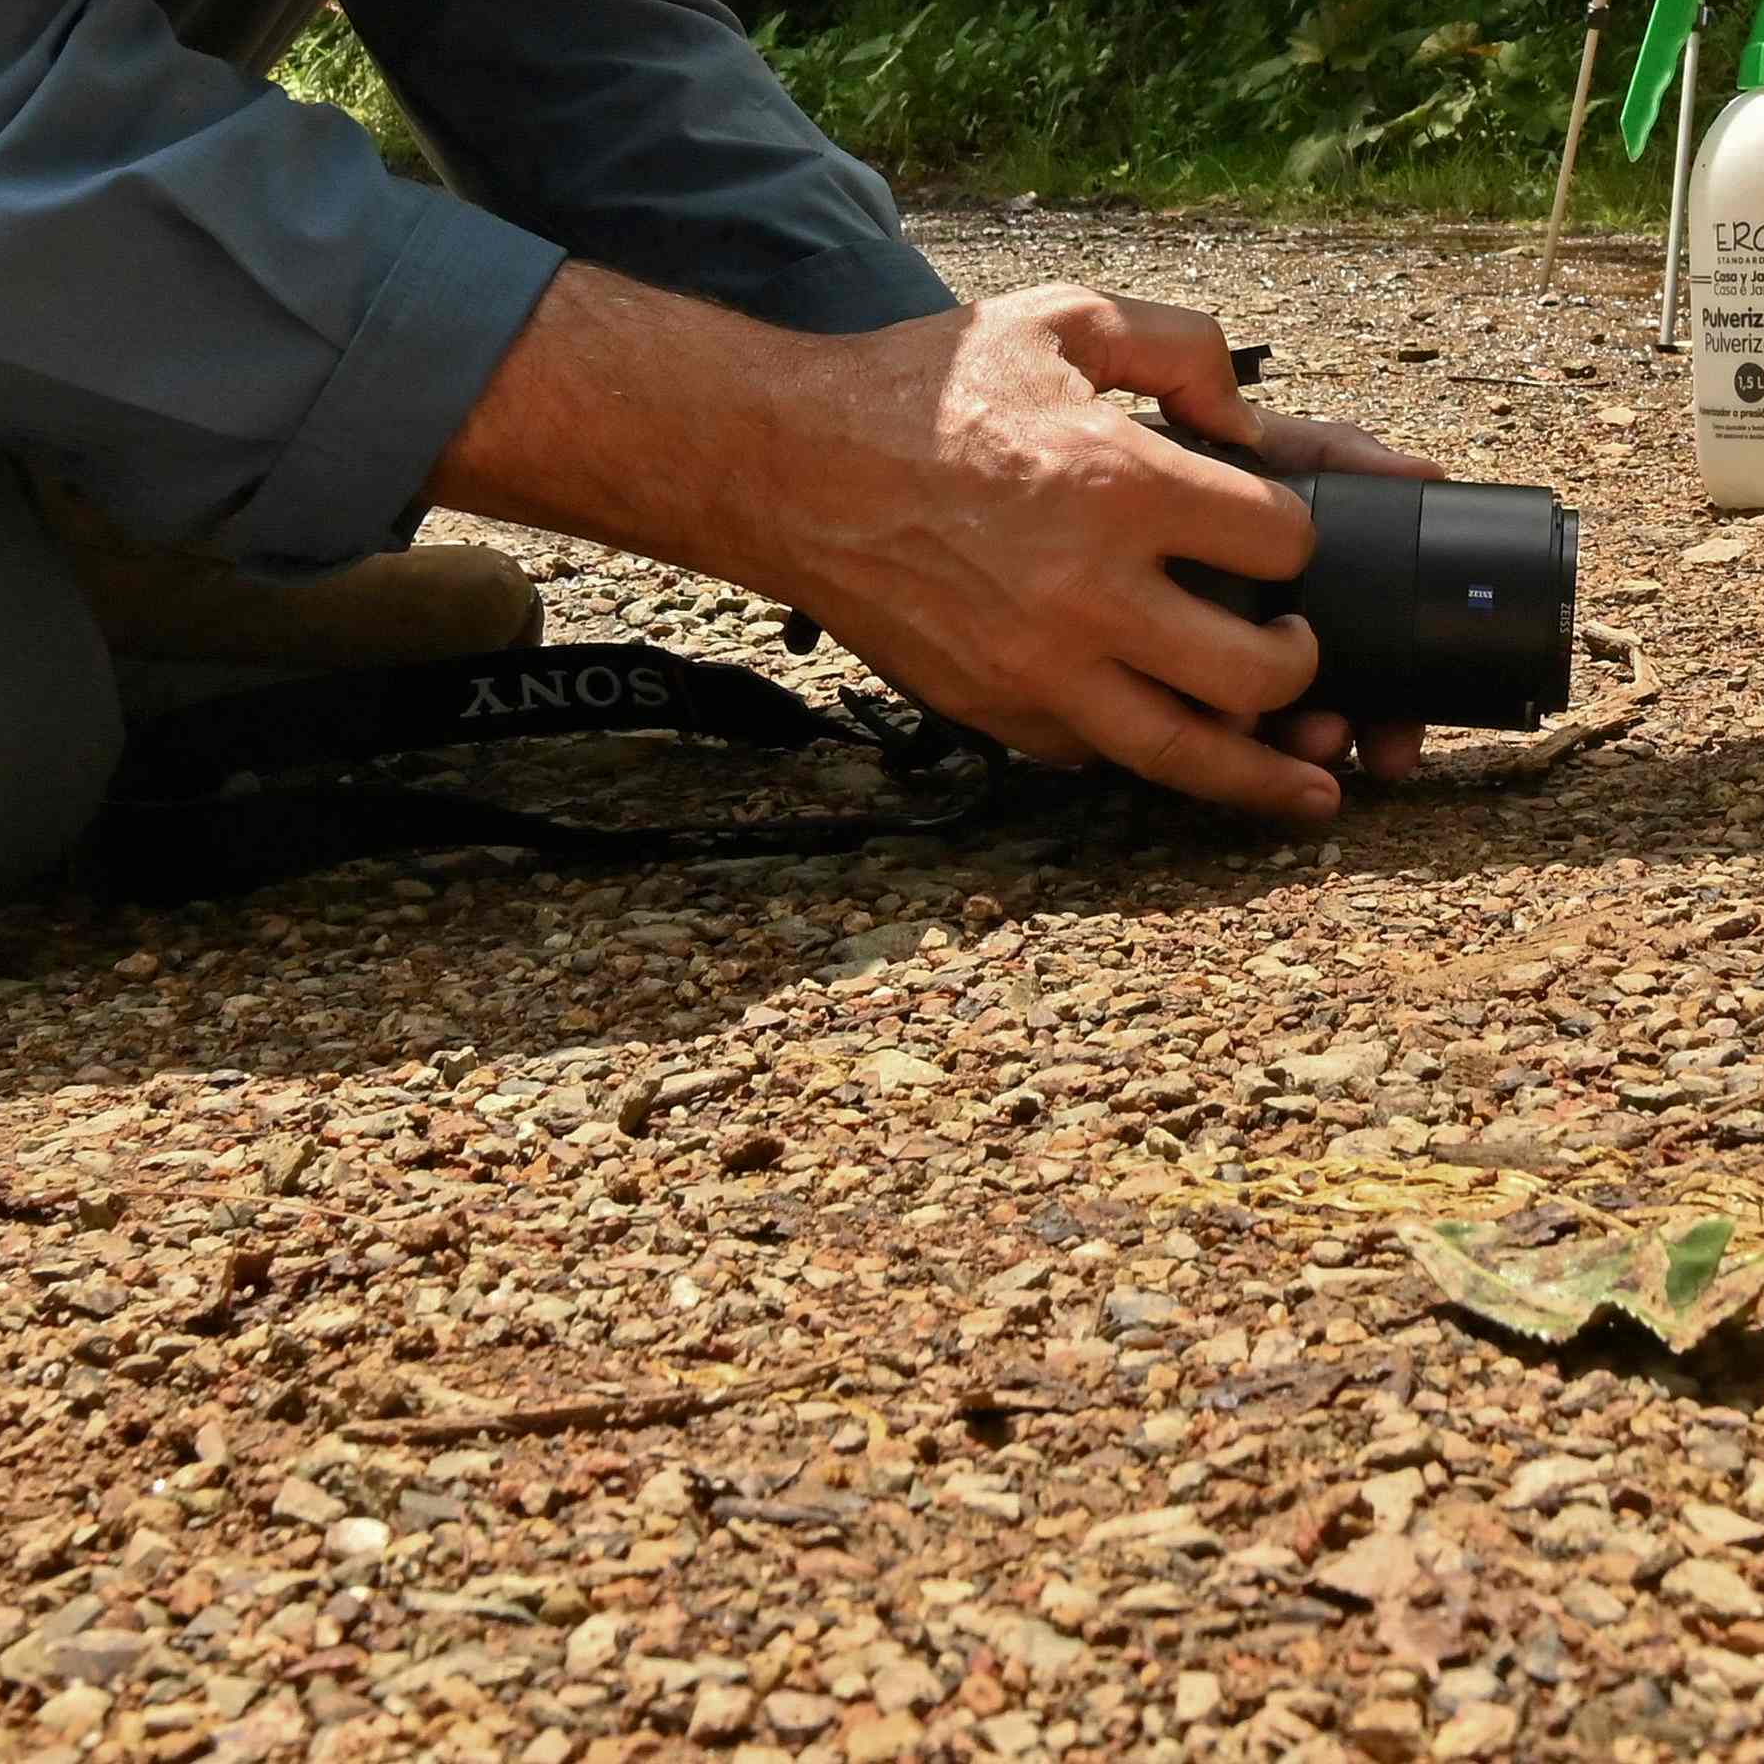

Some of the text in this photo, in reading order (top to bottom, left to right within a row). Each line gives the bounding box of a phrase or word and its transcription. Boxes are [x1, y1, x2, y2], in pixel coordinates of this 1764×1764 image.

[1714, 270, 1737, 282] Casa
[1741, 273, 1747, 284] y
[1714, 284, 1737, 296] Casa
[1738, 375, 1764, 391] 1,5 L
[1468, 589, 1493, 599] ZEISS
[1560, 603, 1571, 633] ZEISS
[459, 666, 670, 718] SONY
